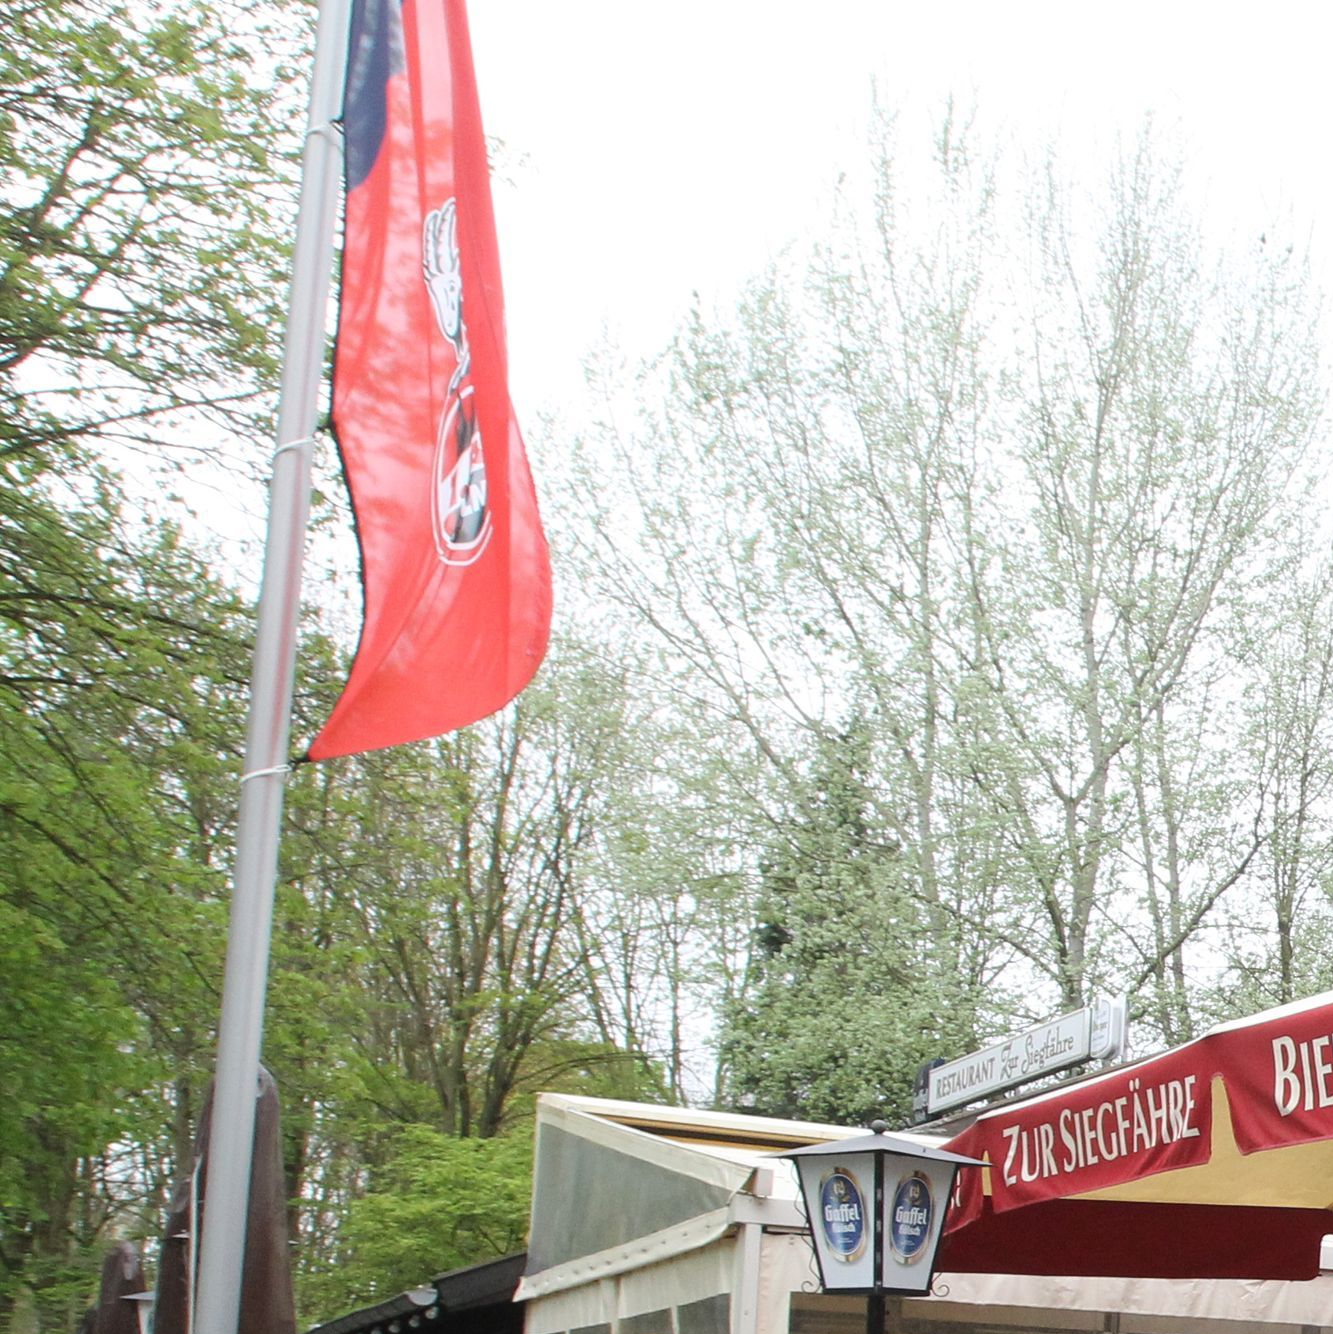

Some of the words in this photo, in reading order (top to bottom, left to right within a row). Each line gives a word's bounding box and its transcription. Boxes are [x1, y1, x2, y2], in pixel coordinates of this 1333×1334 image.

[935, 1057, 996, 1098] RESTAURANT
[1001, 1040, 1020, 1080] Zur
[1021, 1026, 1075, 1075] Siegfähre
[1002, 1122, 1059, 1188] ZUR
[1059, 1074, 1201, 1174] SIEGFÄHRE
[824, 1203, 860, 1224] Gaffel
[895, 1205, 927, 1226] Gaffel
